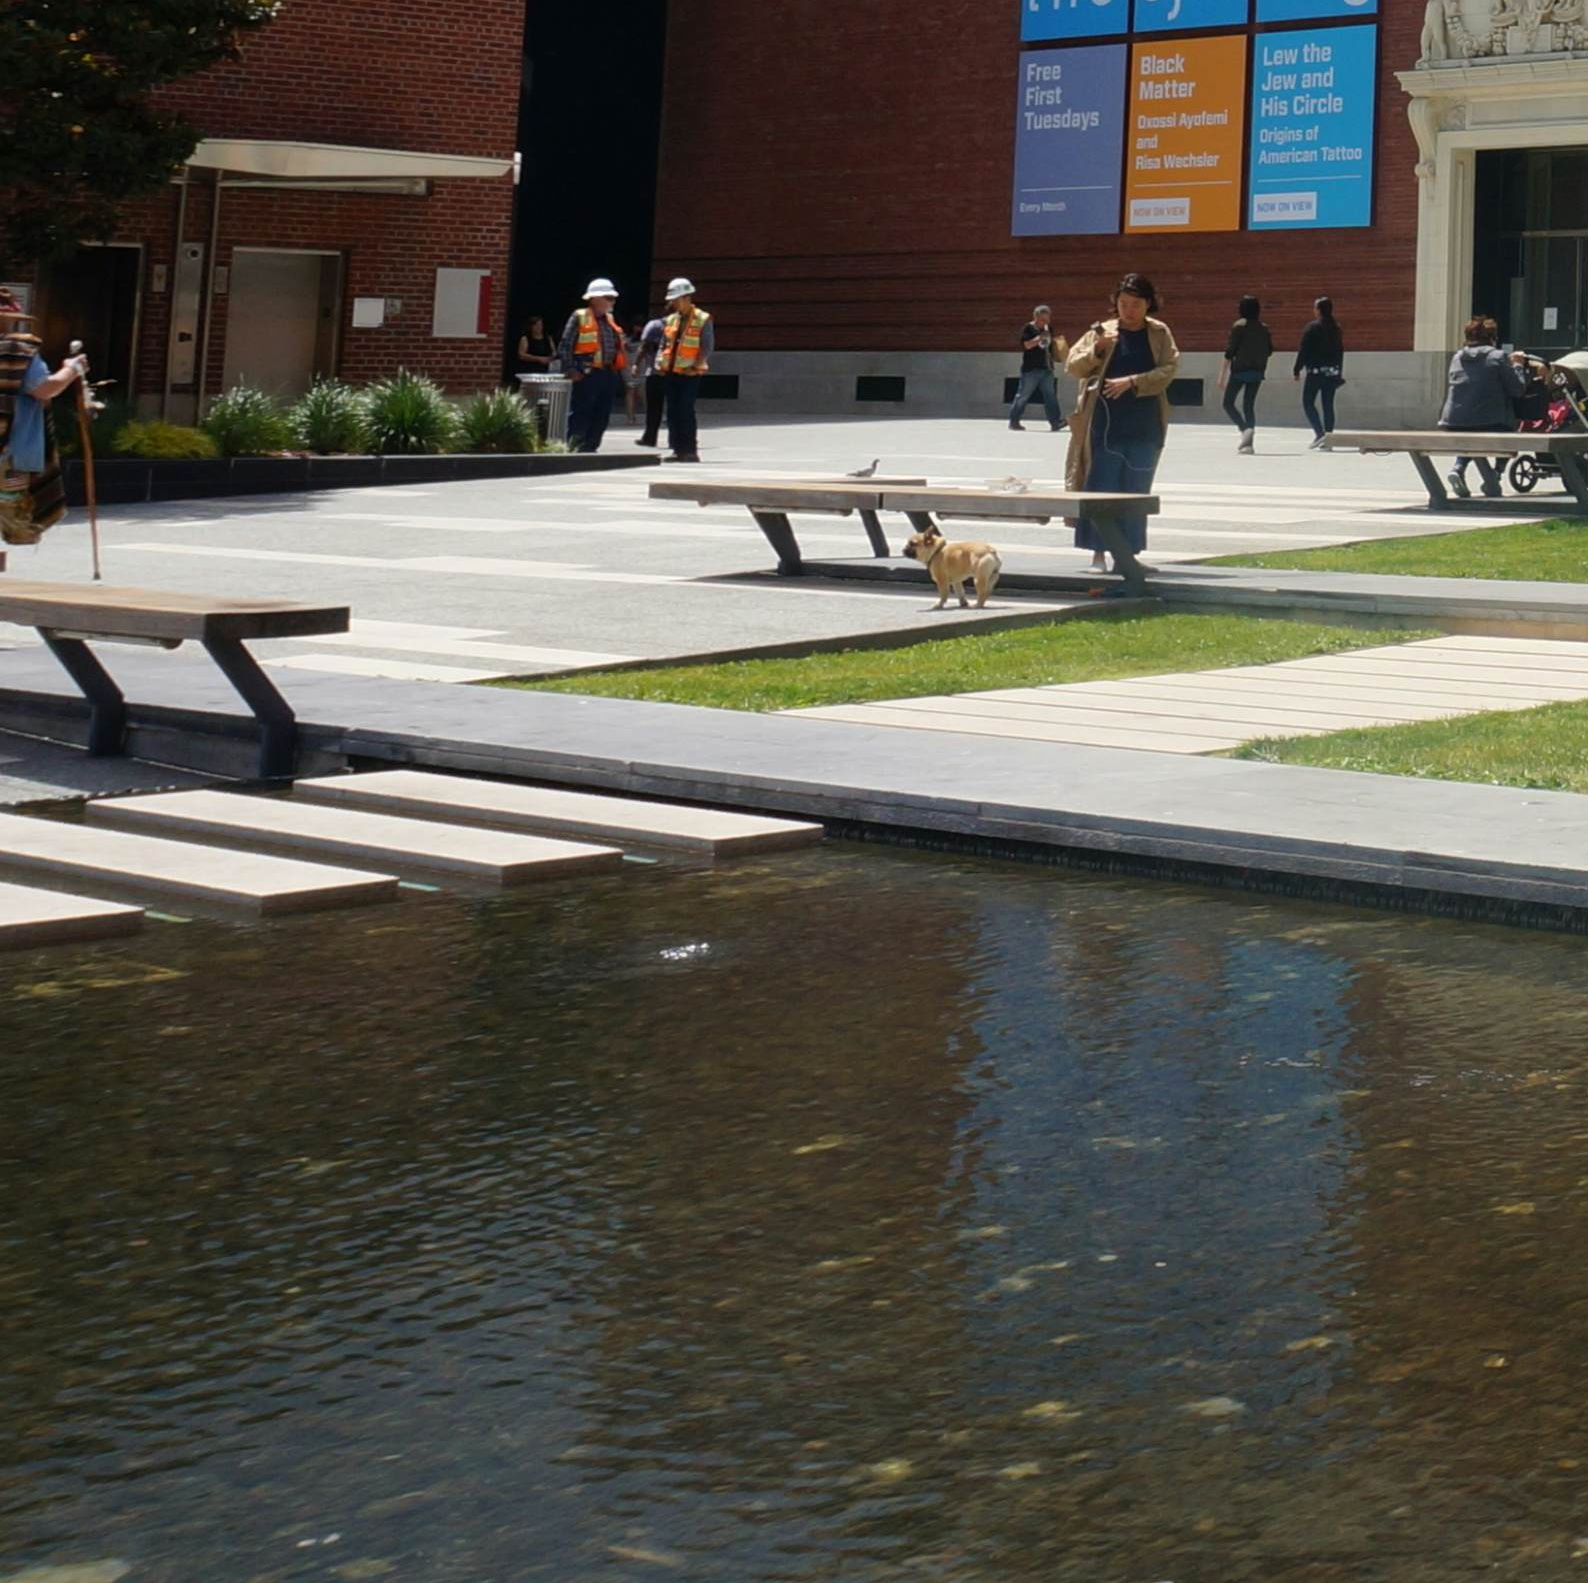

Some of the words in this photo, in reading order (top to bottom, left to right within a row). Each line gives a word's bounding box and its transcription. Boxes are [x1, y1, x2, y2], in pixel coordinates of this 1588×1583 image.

[1140, 53, 1185, 75] Black
[1263, 46, 1299, 66] Lew
[1303, 43, 1332, 63] the
[1026, 63, 1062, 82] Free
[1261, 71, 1297, 91] Jew
[1301, 67, 1334, 88] and
[1025, 86, 1062, 106] First
[1139, 79, 1196, 100] Matter
[1261, 96, 1288, 117] His
[1293, 93, 1344, 115] Circle
[1024, 109, 1100, 131] Tuesdays
[1137, 112, 1177, 129] Oxossi
[1178, 109, 1228, 130] Ayofemi
[1136, 135, 1158, 149] and
[1259, 126, 1303, 145] Origins
[1305, 125, 1320, 141] of
[1135, 154, 1161, 169] Risa
[1163, 152, 1220, 168] Wechsler
[1258, 149, 1318, 165] American
[1321, 146, 1363, 162] Tattoo
[1019, 202, 1041, 214] Every
[1133, 207, 1151, 217] NOW
[1152, 207, 1165, 216] ON
[1166, 205, 1187, 216] VIEW
[1256, 202, 1276, 213] NOW
[1278, 202, 1291, 212] ON
[1292, 200, 1314, 211] VIEW
